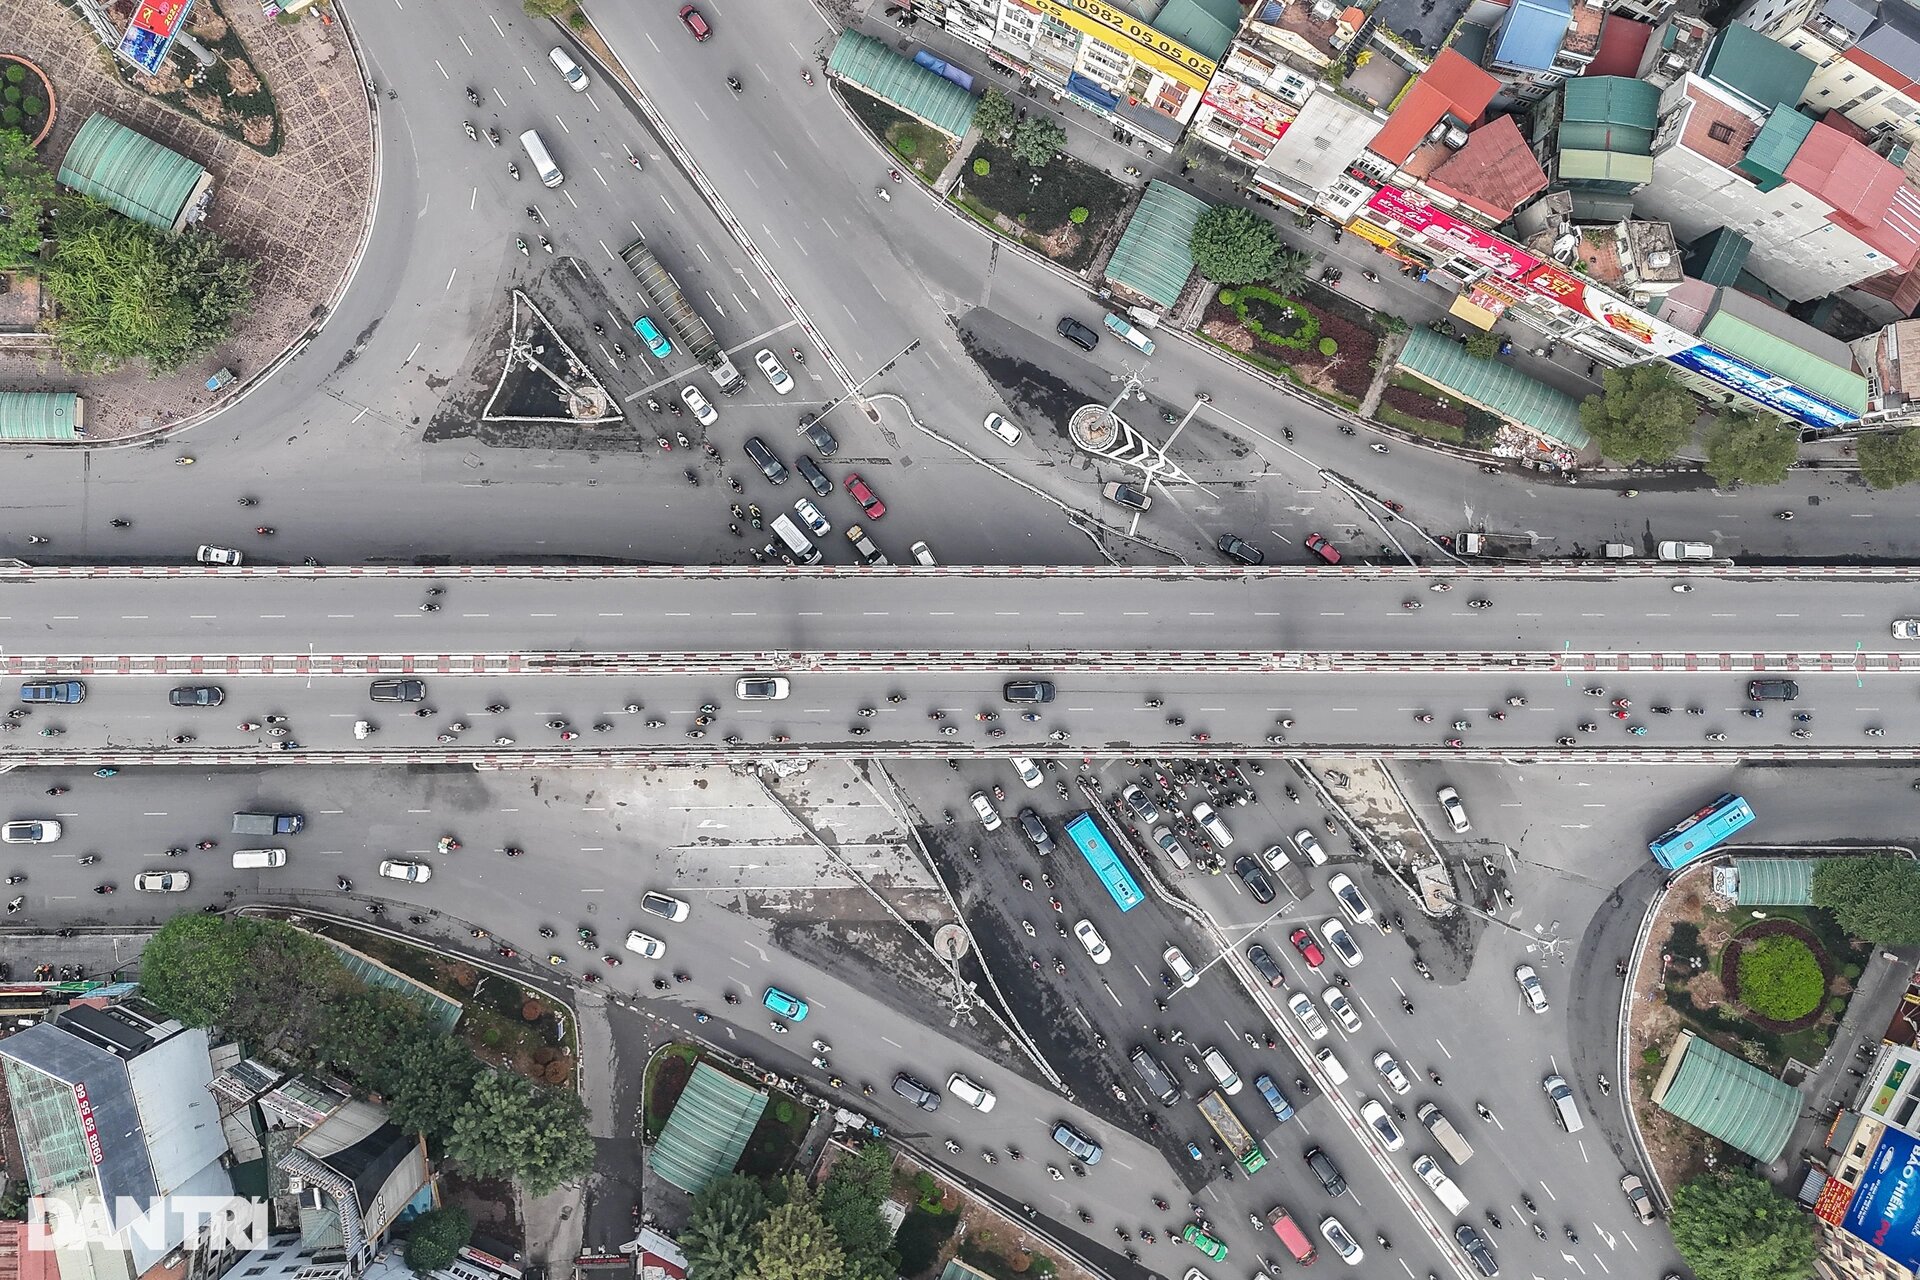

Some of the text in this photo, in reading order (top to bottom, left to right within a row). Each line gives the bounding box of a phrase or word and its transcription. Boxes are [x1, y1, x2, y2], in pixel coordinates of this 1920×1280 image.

[164, 3, 178, 25] 2024
[1036, 0, 1062, 16] 05
[1077, 0, 1212, 75] 0982 05 05 05
[75, 1083, 103, 1163] 0988 59 55 66
[1872, 1218, 1891, 1246] PVI
